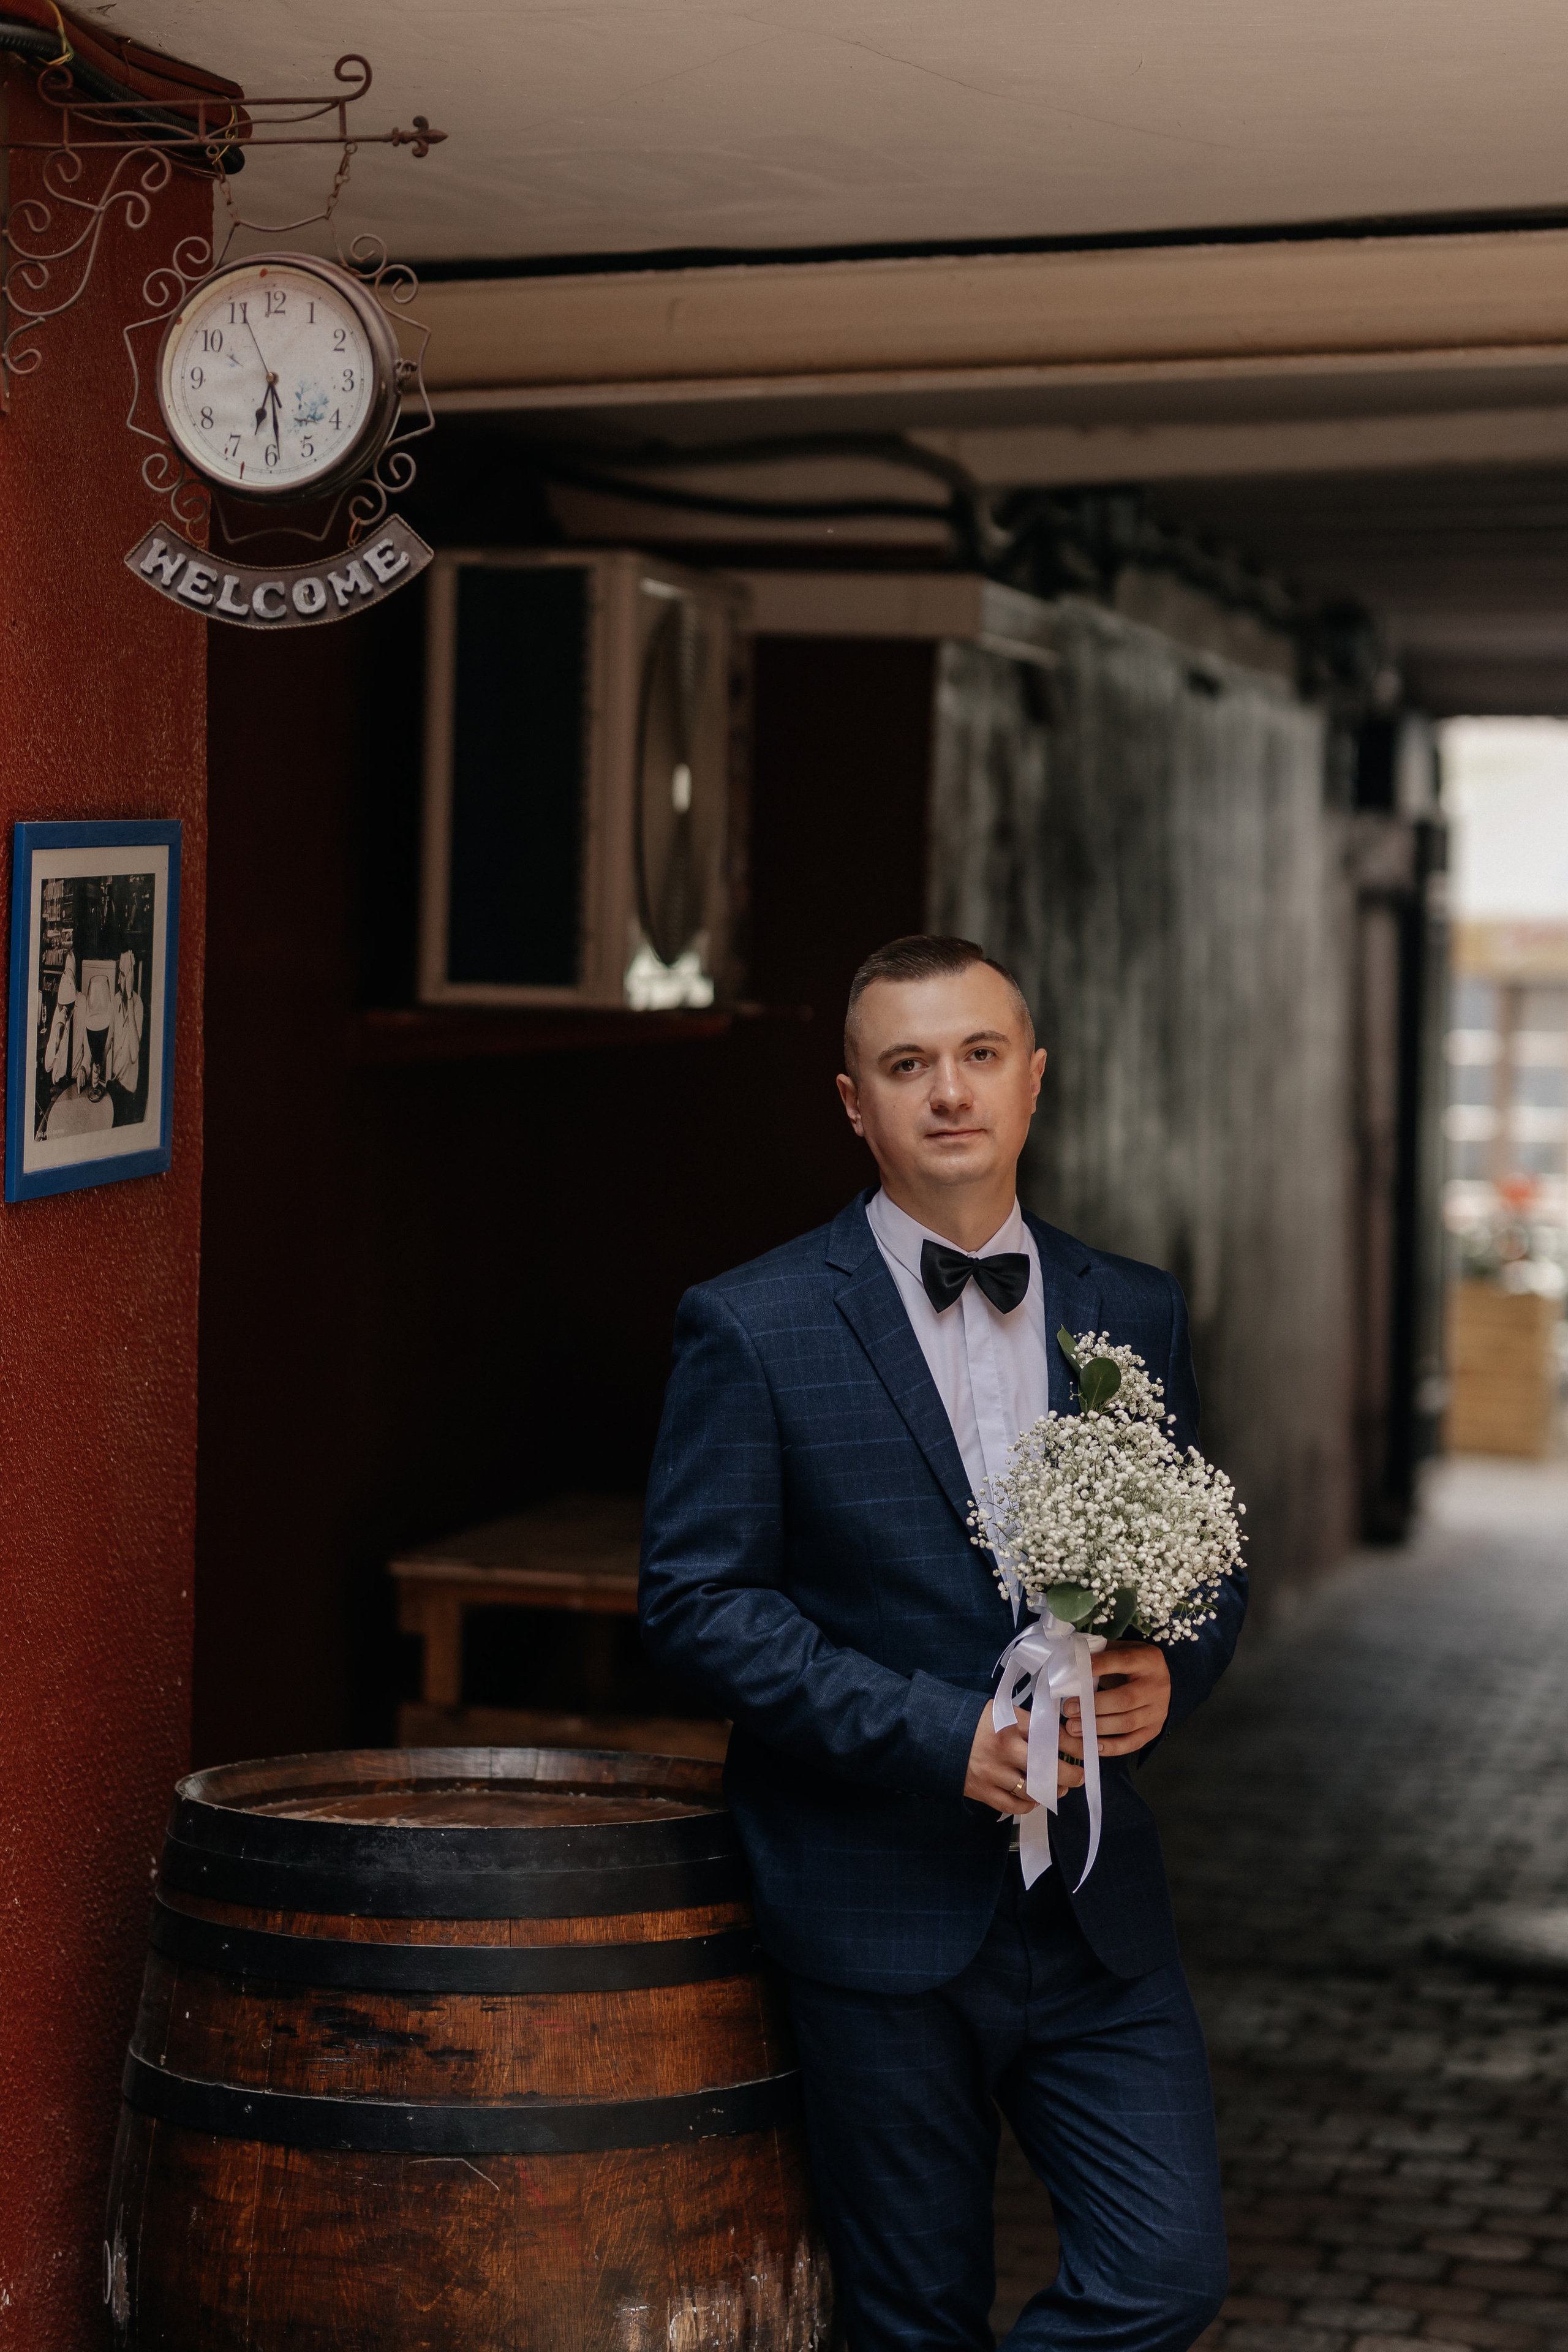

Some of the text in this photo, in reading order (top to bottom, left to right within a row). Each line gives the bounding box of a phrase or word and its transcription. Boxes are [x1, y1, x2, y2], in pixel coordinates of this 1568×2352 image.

[229, 302, 248, 323] 11
[265, 291, 287, 314] 12
[307, 301, 315, 324] 1
[202, 329, 224, 352] 10
[333, 329, 345, 352] 2
[190, 366, 203, 389] 9
[342, 369, 355, 391] 3
[200, 406, 213, 429] 8
[329, 409, 342, 430] 4
[229, 435, 241, 457] 7
[265, 443, 277, 467] 6
[301, 435, 314, 458] 5
[140, 538, 409, 619] WELCOME
